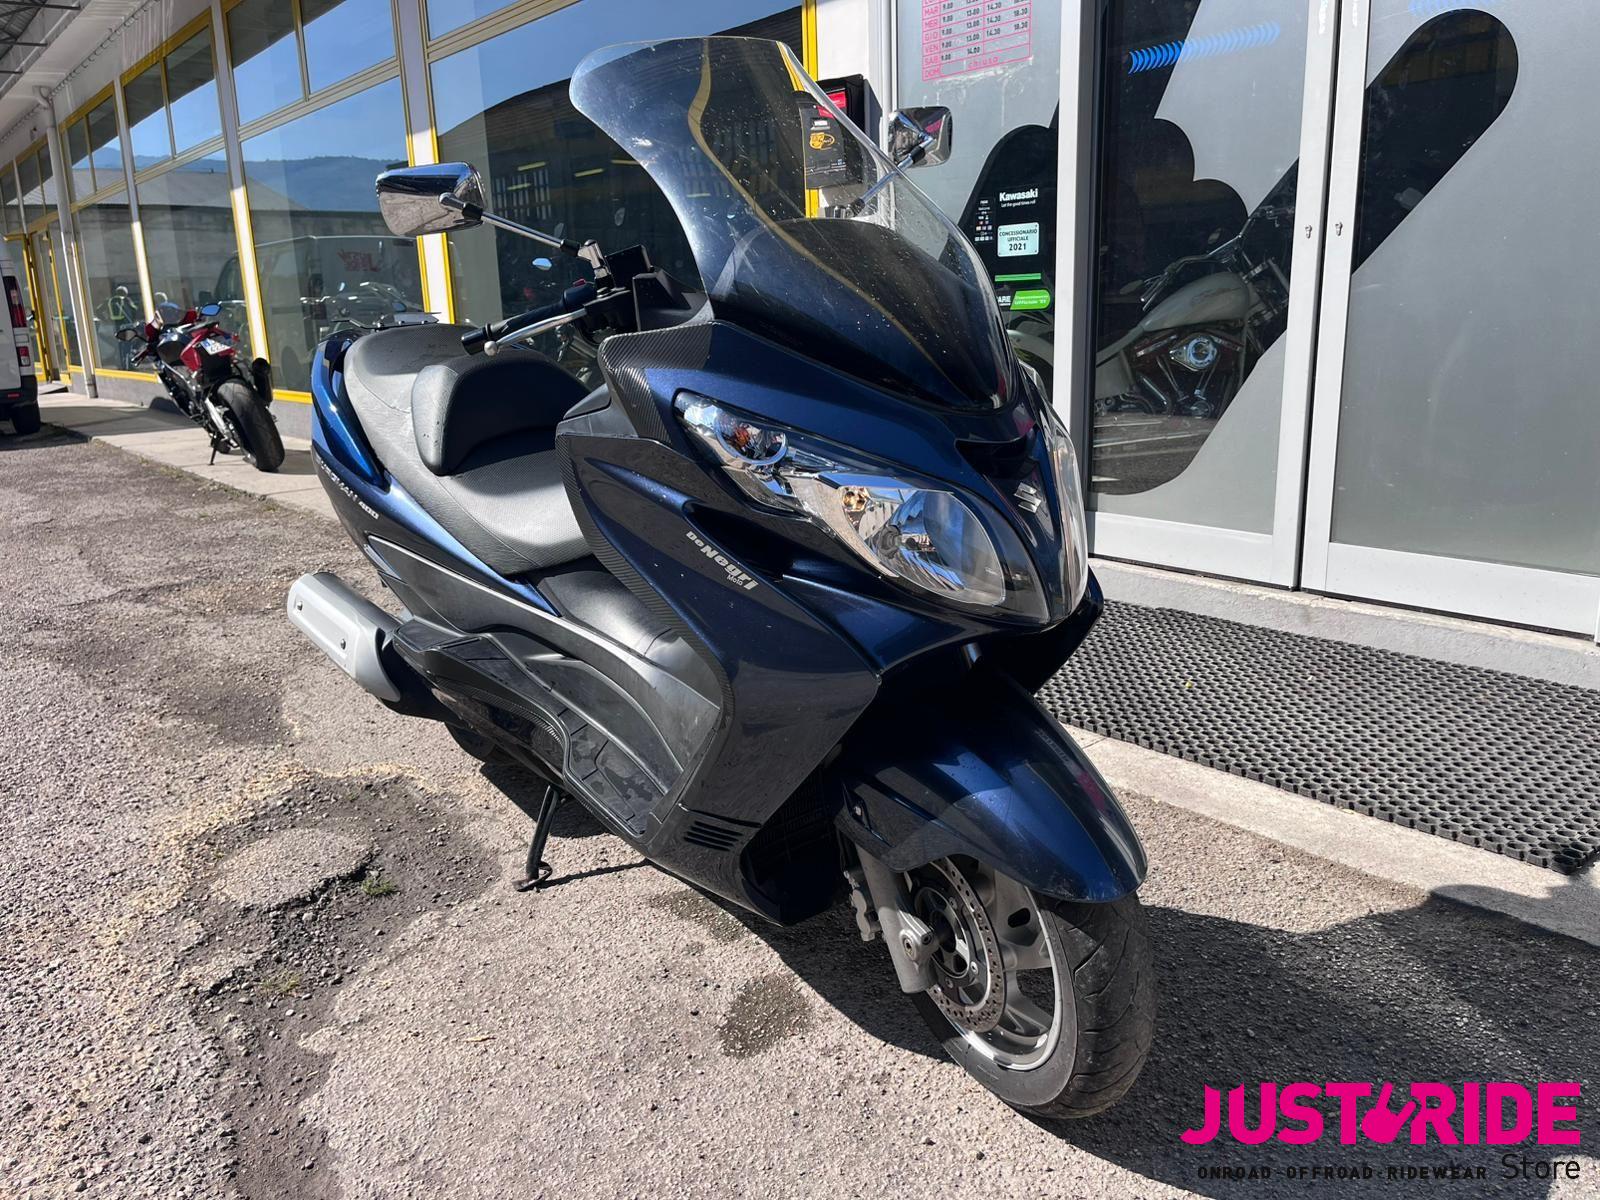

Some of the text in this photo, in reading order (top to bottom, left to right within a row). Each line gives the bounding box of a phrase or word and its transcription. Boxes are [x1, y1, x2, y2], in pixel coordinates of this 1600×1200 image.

[999, 188, 1038, 202] Kawasaki
[999, 228, 1038, 237] CONCESSIONARIO
[1008, 242, 1027, 251] 2021
[358, 501, 379, 519] 400
[726, 574, 744, 586] Moto
